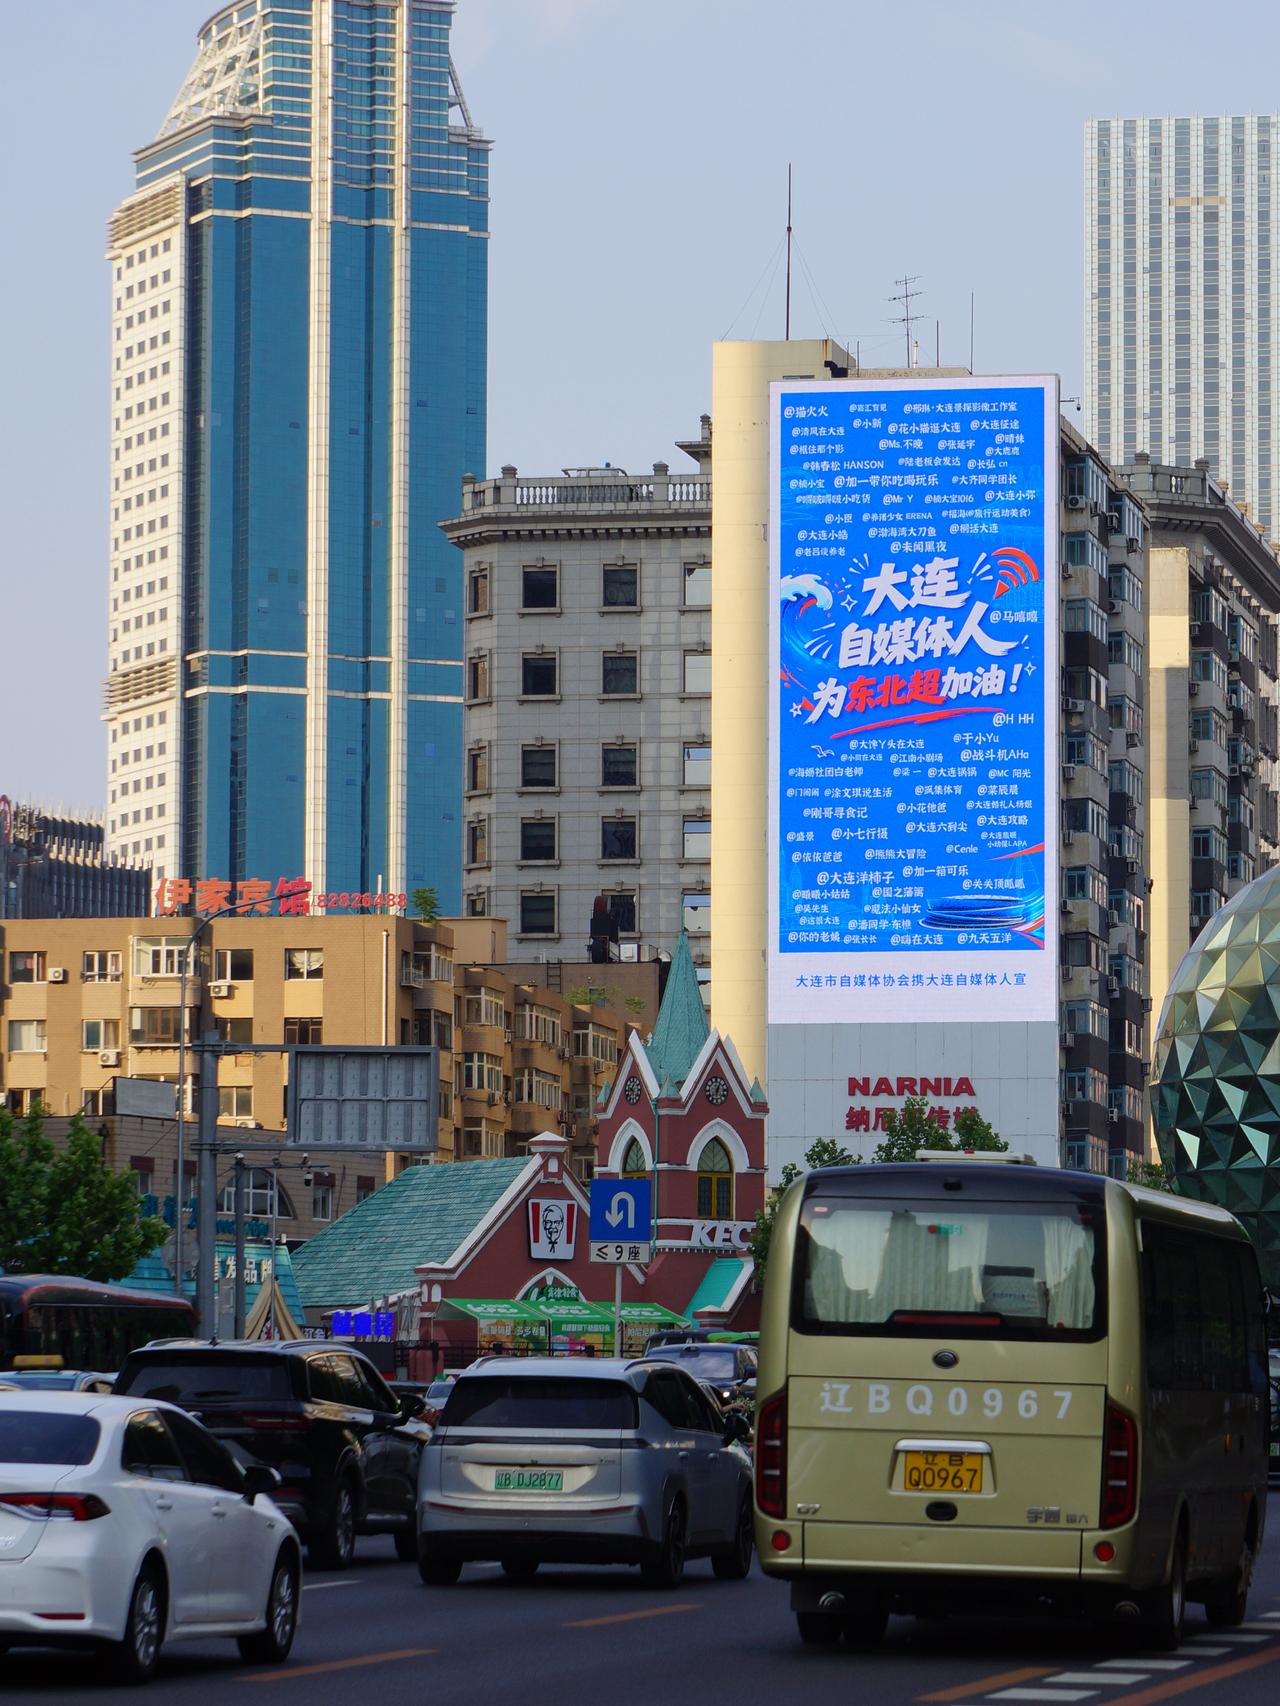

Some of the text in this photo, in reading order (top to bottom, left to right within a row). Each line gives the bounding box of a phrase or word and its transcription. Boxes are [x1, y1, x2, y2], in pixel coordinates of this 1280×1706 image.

[853, 419, 881, 428] @小新
[844, 461, 883, 469] HANSON
[834, 474, 938, 488] @加一带你吃喝玩乐
[907, 495, 913, 503] Y
[862, 556, 972, 616] 大连
[839, 601, 1019, 668] 自媒体人
[157, 877, 312, 916] 伊家宾馆
[796, 973, 1027, 988] 大连市自媒体协会携大连自媒体人宣
[848, 1077, 976, 1097] NARNIA
[908, 1468, 978, 1487] Q0967
